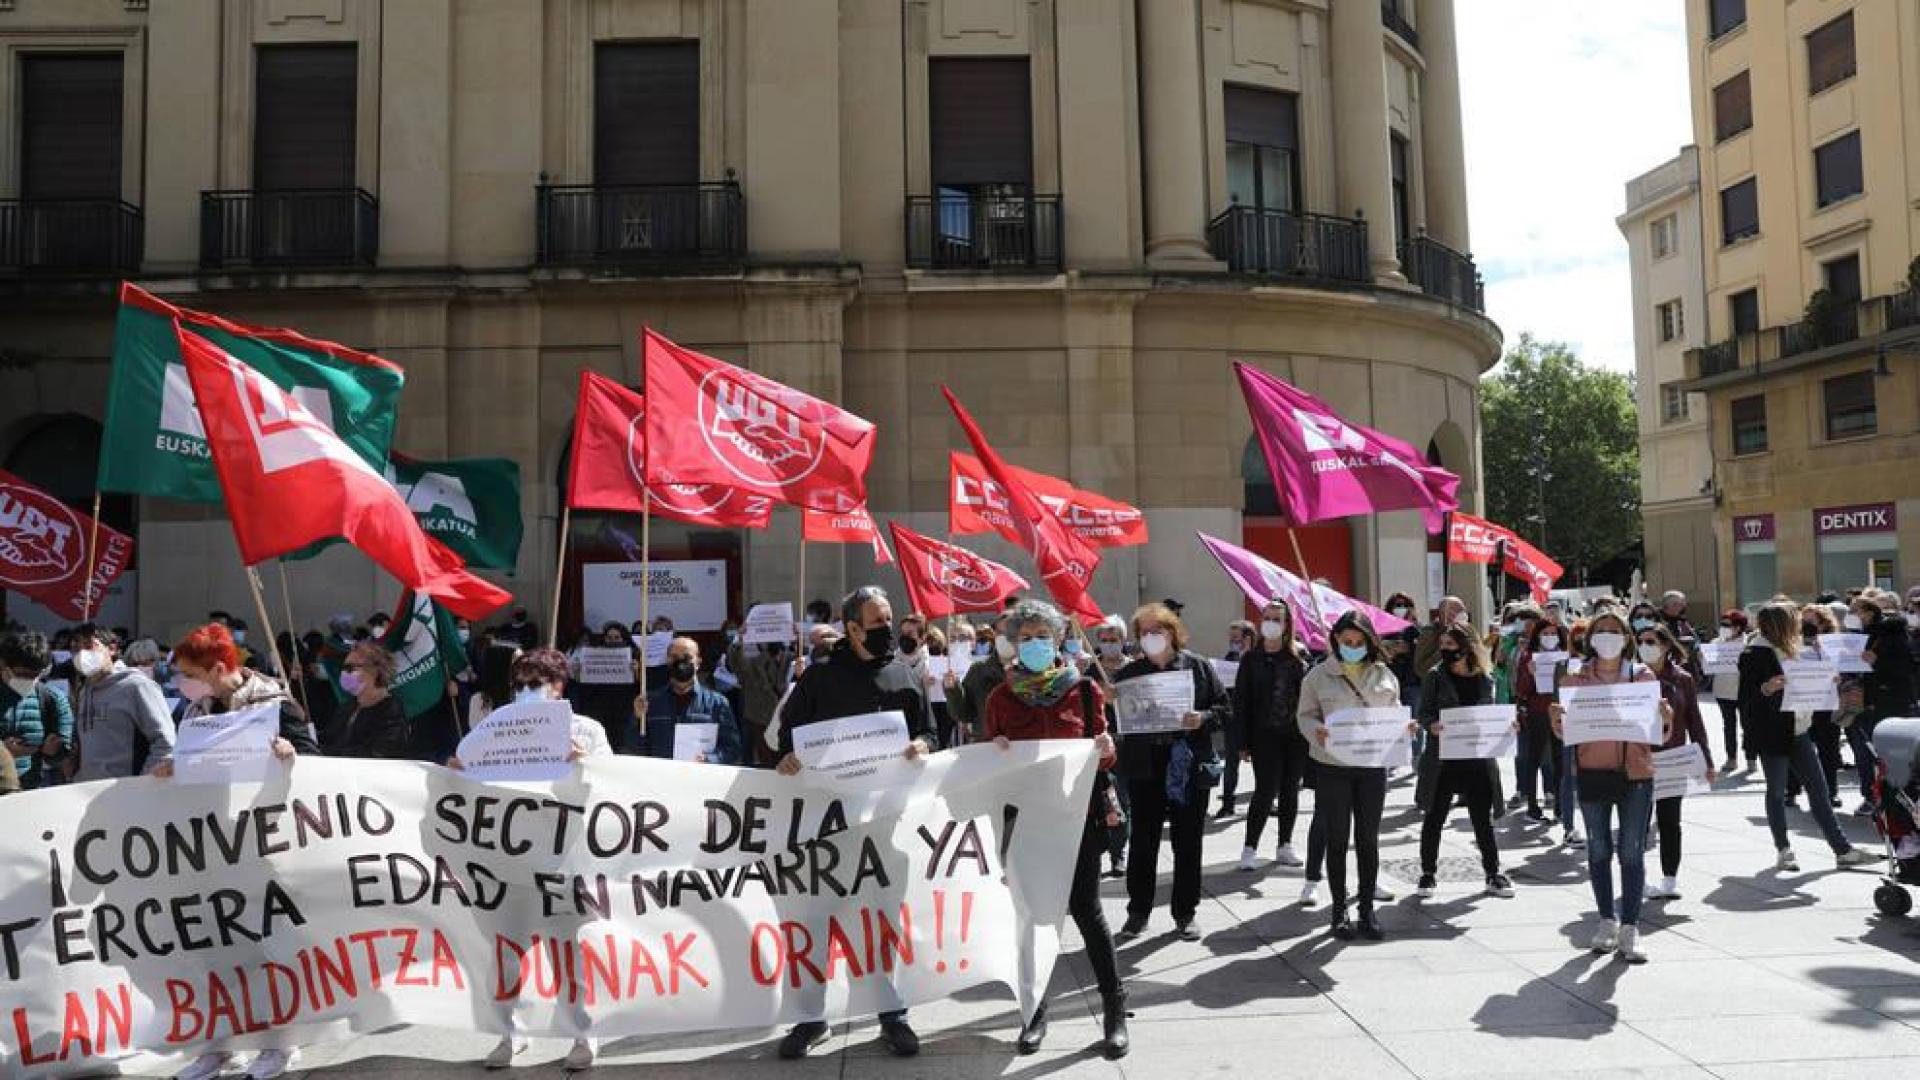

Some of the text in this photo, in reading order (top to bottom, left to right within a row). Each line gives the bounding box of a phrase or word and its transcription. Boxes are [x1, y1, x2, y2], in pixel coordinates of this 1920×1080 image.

[1820, 510, 1886, 530] DENTIX
[0, 803, 1019, 981] TERCERA EDAD EN NAVARRA YA!
[42, 794, 850, 909] ¡CONVENIO SECTOR DE LA
[13, 982, 132, 1067] LAN
[165, 928, 465, 1044] BALDINTZA
[495, 932, 709, 1005] DUINAK
